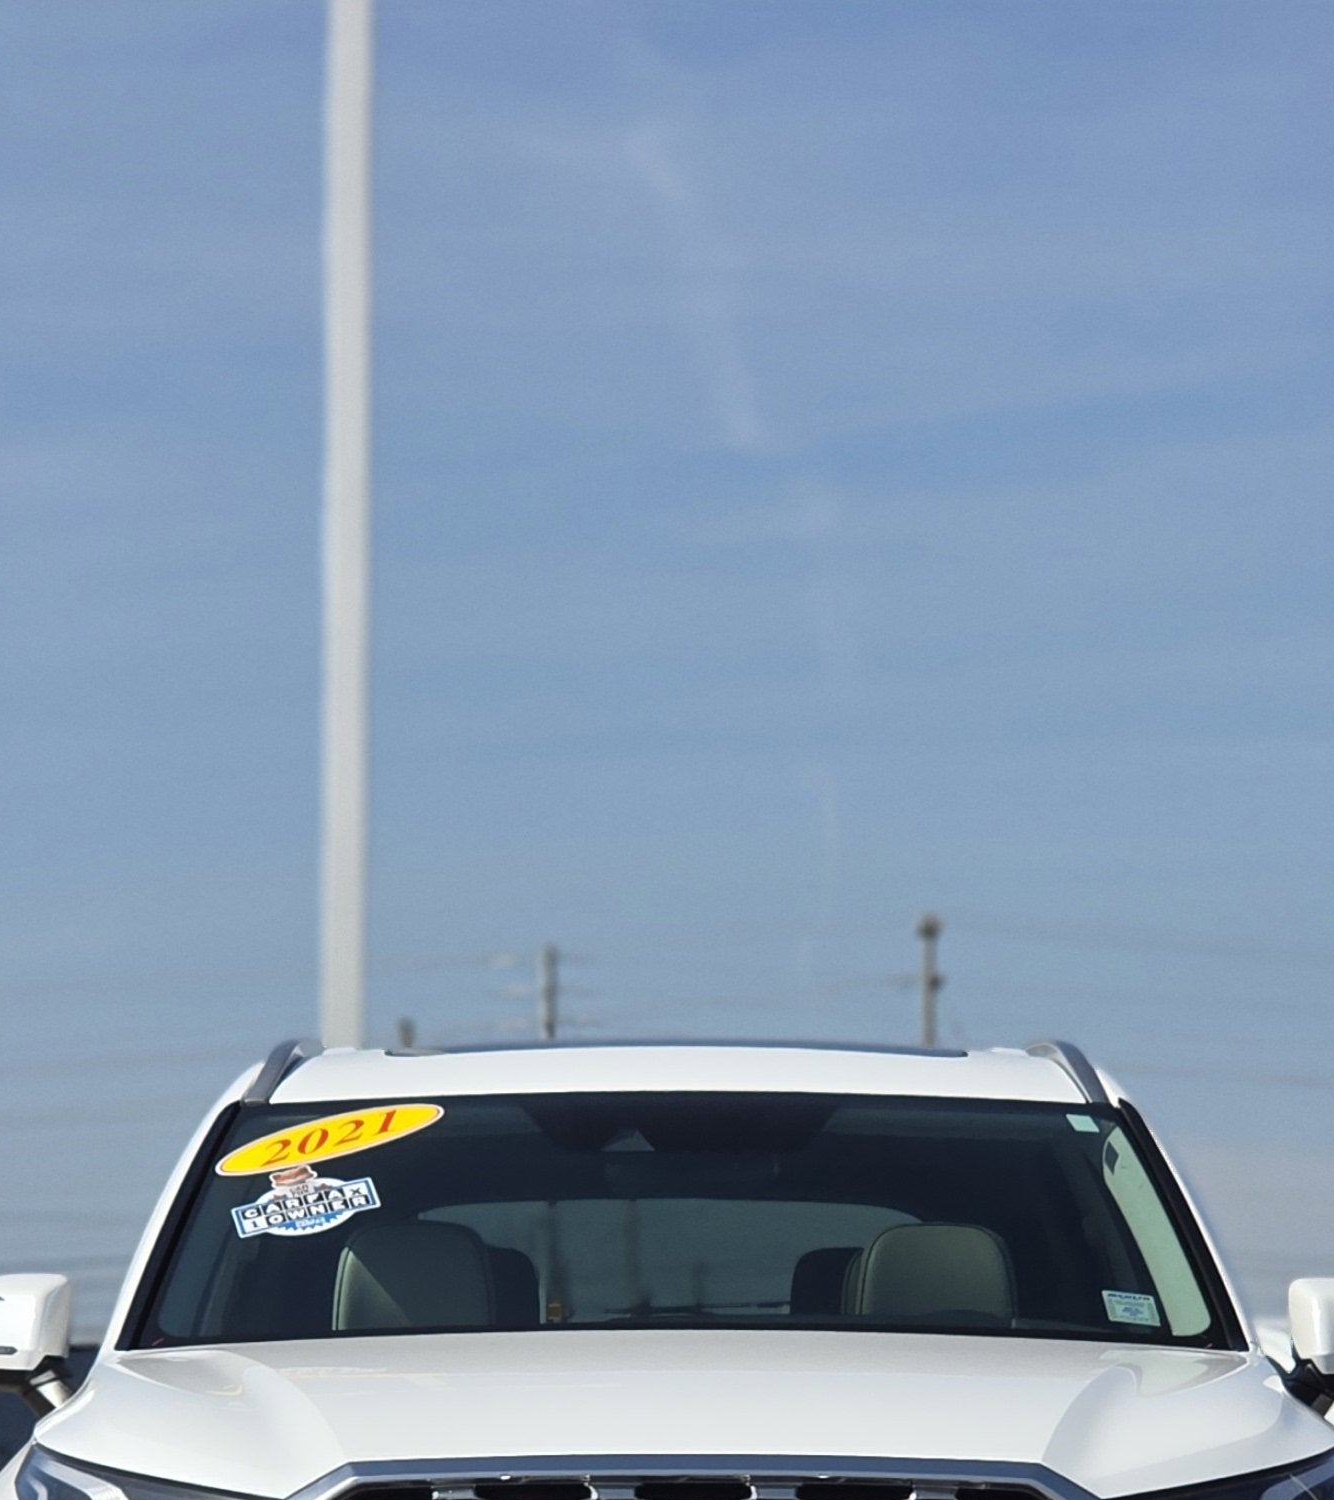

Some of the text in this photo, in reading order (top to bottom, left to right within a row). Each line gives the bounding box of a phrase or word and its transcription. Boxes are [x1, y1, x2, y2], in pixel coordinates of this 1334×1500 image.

[260, 1109, 397, 1168] 2021
[243, 1186, 363, 1219] CARFAX
[267, 1196, 370, 1225] OWNER
